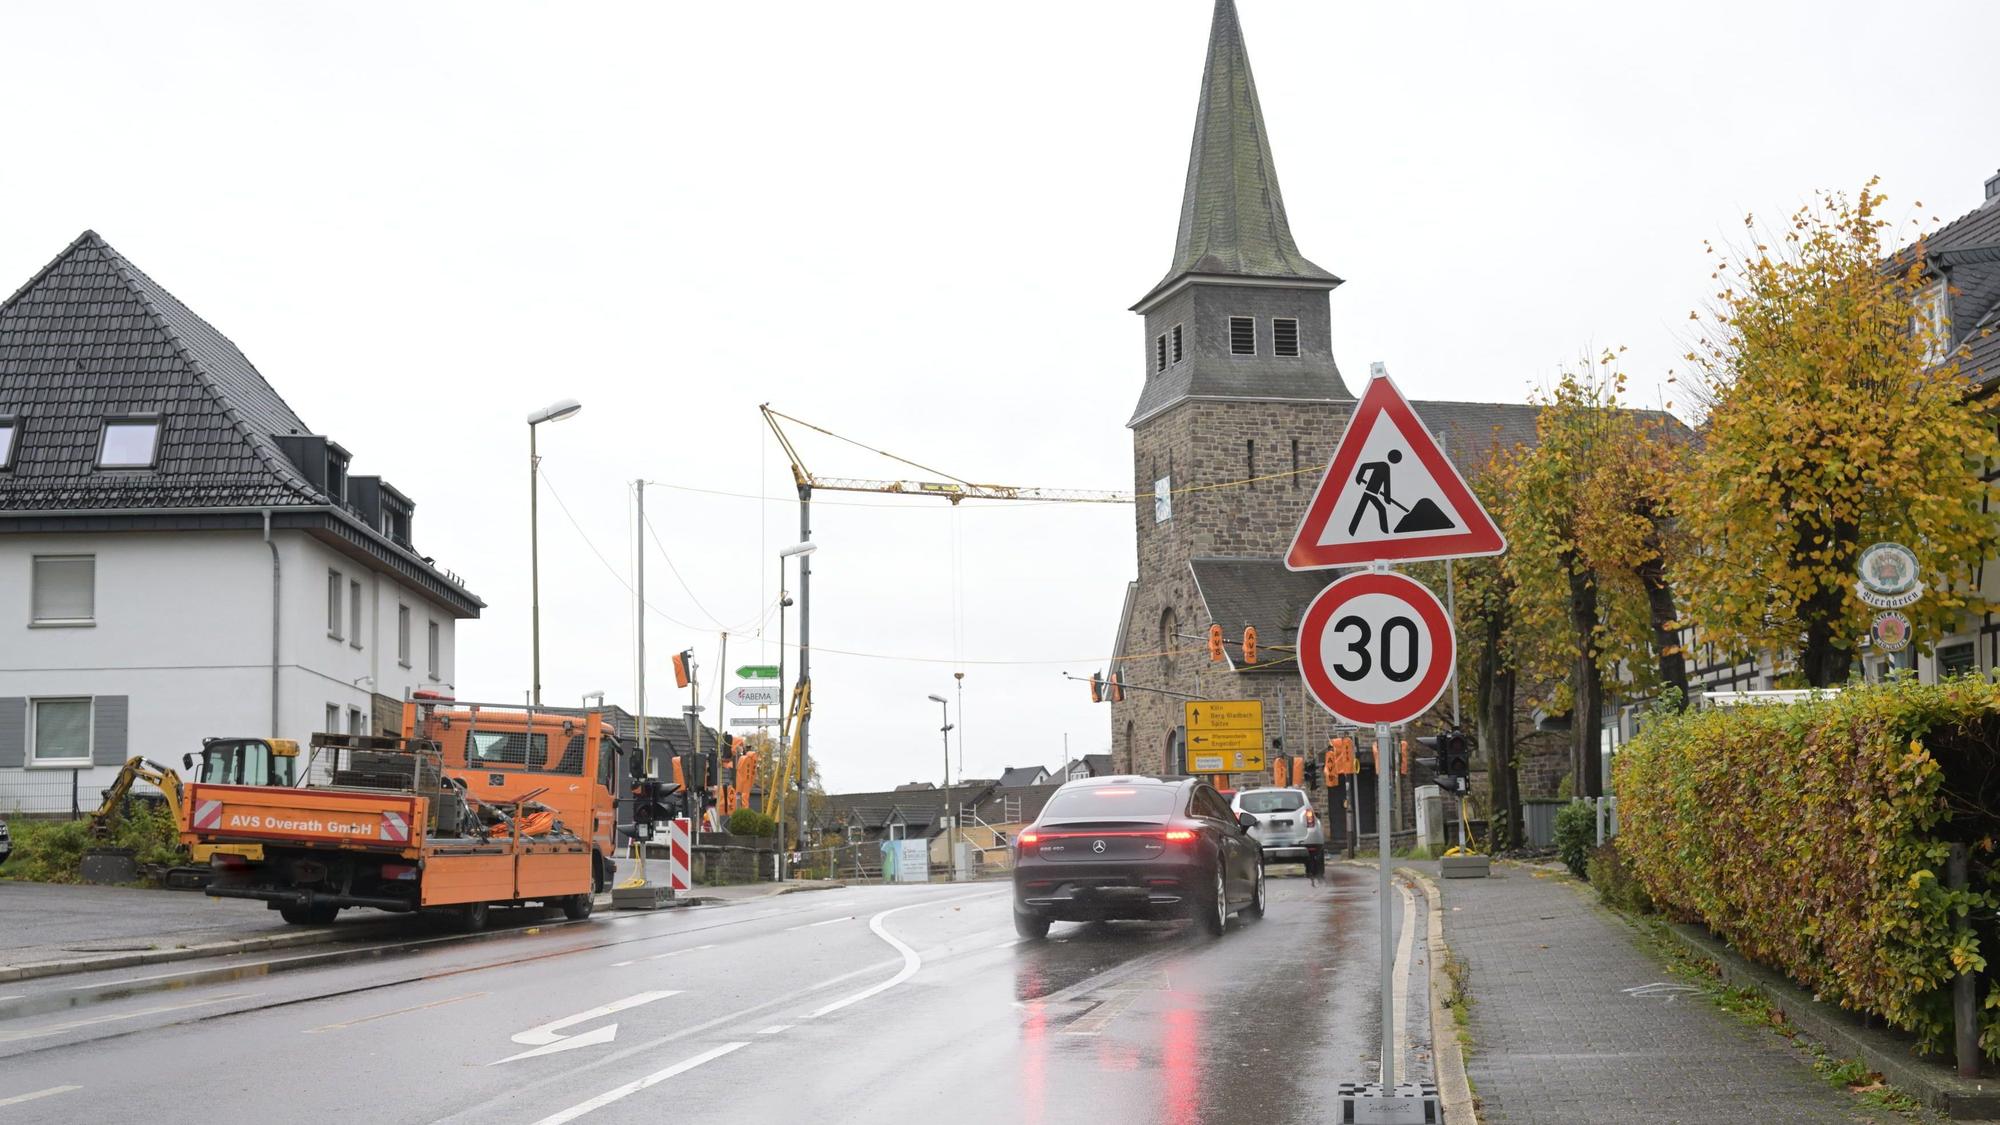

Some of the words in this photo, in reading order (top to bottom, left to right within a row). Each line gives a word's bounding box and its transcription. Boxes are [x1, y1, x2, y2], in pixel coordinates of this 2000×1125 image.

[1863, 591, 1918, 608] Biergarten
[1333, 615, 1419, 683] 30
[231, 815, 260, 827] AVS
[265, 817, 322, 832] Overath
[327, 821, 372, 835] GmbH
